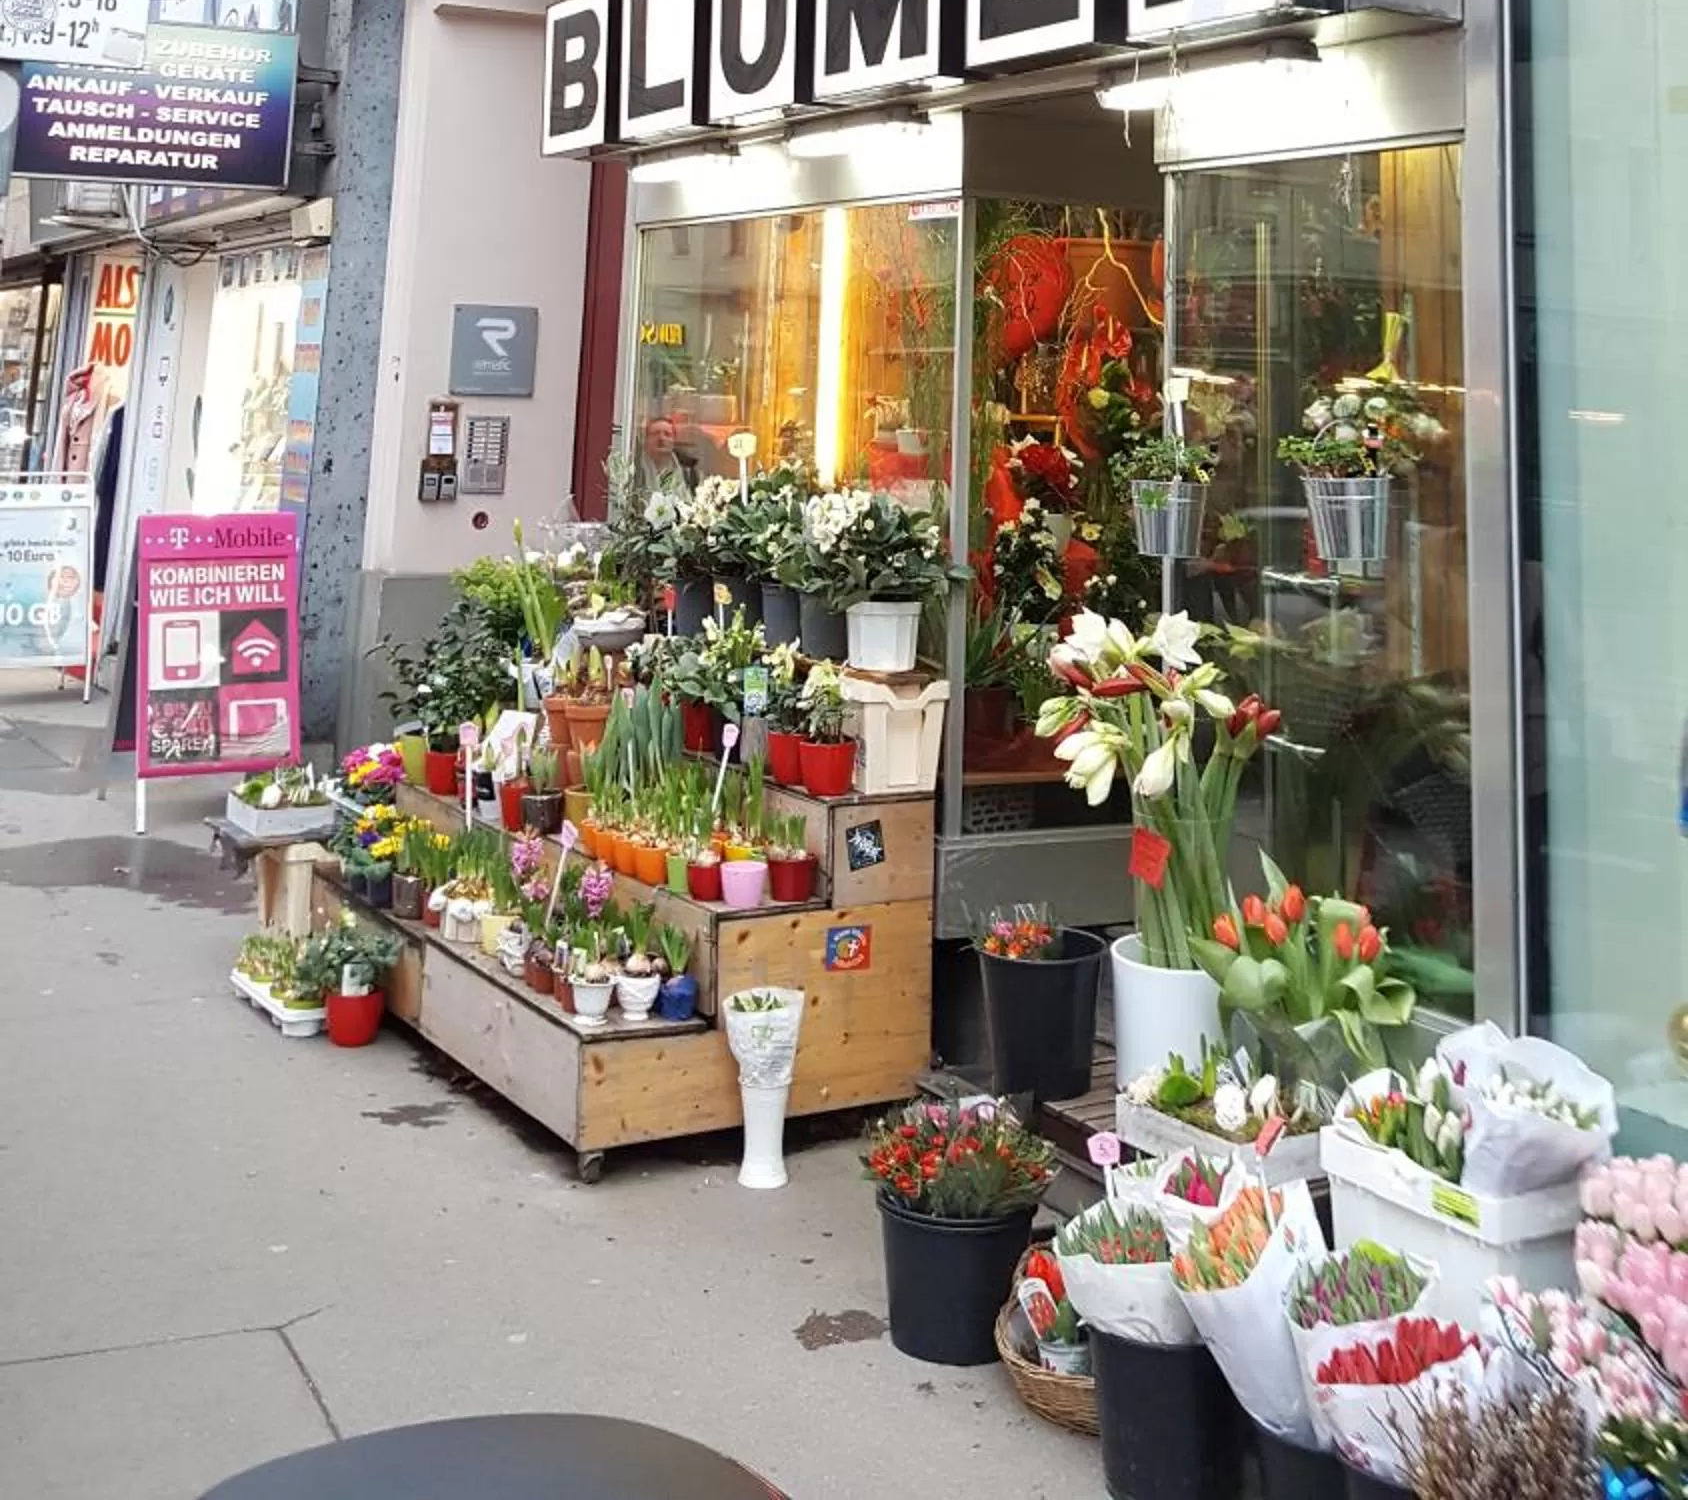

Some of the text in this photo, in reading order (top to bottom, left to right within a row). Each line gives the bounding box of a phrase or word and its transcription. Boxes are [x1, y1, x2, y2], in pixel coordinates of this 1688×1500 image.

[27, 74, 134, 97] ANKAUF
[154, 83, 270, 107] VERKAUF
[32, 97, 135, 120] TAUSCH
[156, 107, 261, 129] SERVICE
[48, 121, 241, 149] ANMELDUNGEN
[69, 145, 219, 170] REPARATUR
[214, 528, 286, 549] Mobile
[150, 564, 286, 586] KOMBINIEREN
[150, 585, 285, 607] WIE ICH WILL
